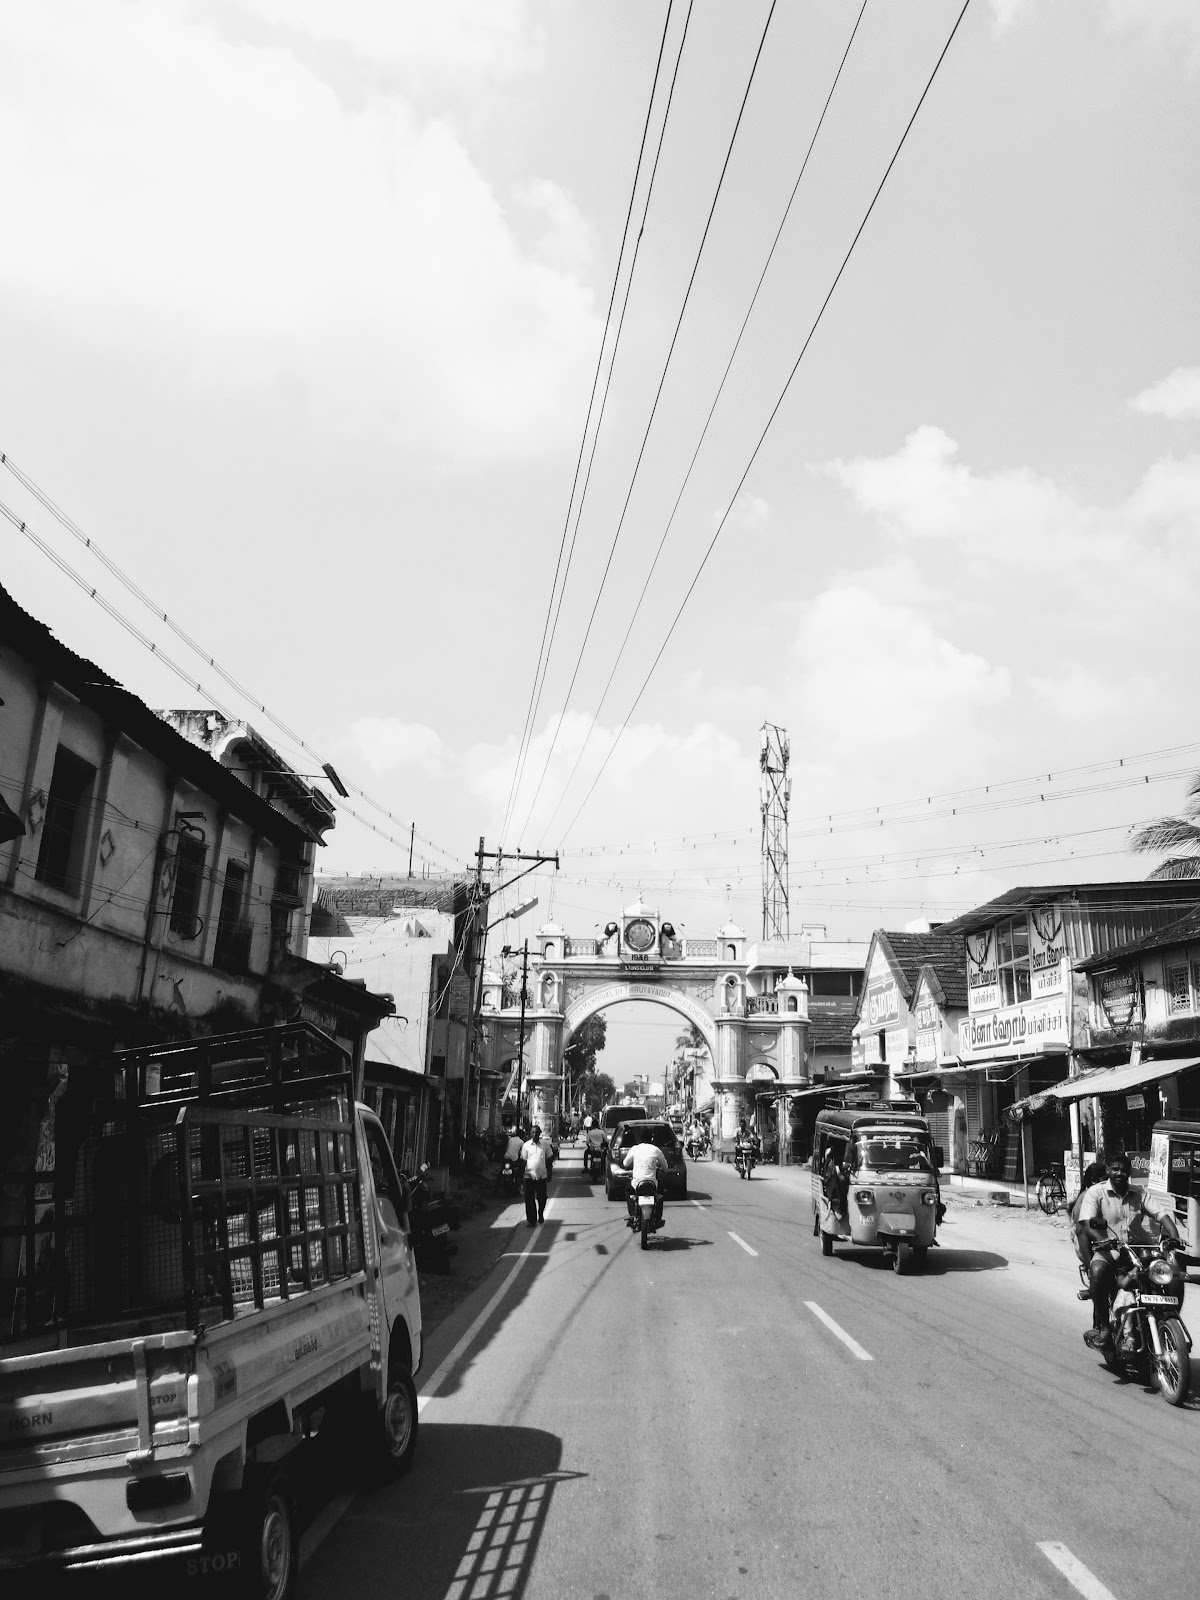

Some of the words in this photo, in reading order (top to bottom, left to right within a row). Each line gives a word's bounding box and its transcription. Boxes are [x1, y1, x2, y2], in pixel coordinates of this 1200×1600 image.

[563, 1007, 584, 1029] VICTORY
[583, 992, 613, 1009] MEMORIAL
[615, 988, 623, 996] BY
[1028, 1009, 1063, 1035] பர்னிச்சர்
[150, 1394, 177, 1406] STOP
[9, 1413, 53, 1433] HORN
[187, 1551, 239, 1577] STOP
